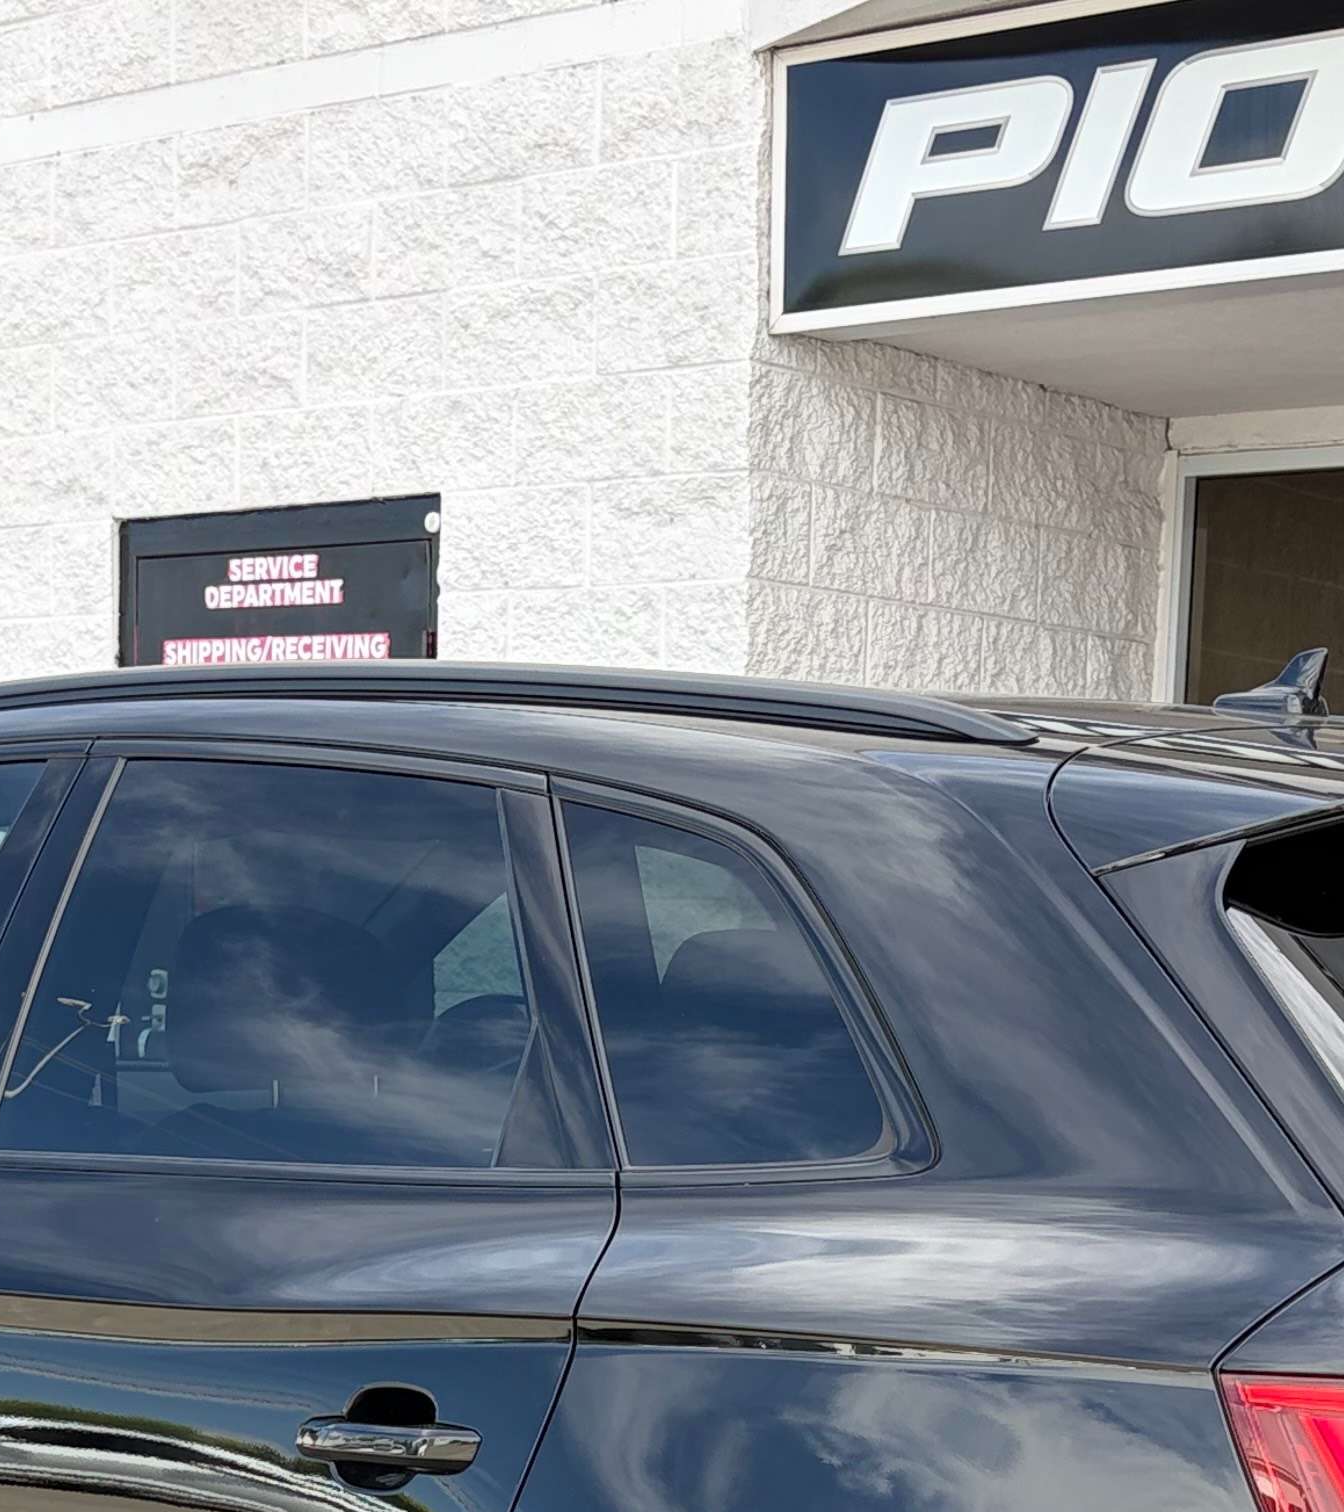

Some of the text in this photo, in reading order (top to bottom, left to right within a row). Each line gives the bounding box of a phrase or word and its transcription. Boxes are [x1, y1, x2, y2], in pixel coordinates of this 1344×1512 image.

[229, 554, 319, 582] SERVICE
[204, 579, 344, 609] DEPARTMENT
[163, 632, 391, 665] SHIPPING/RECEIVING
